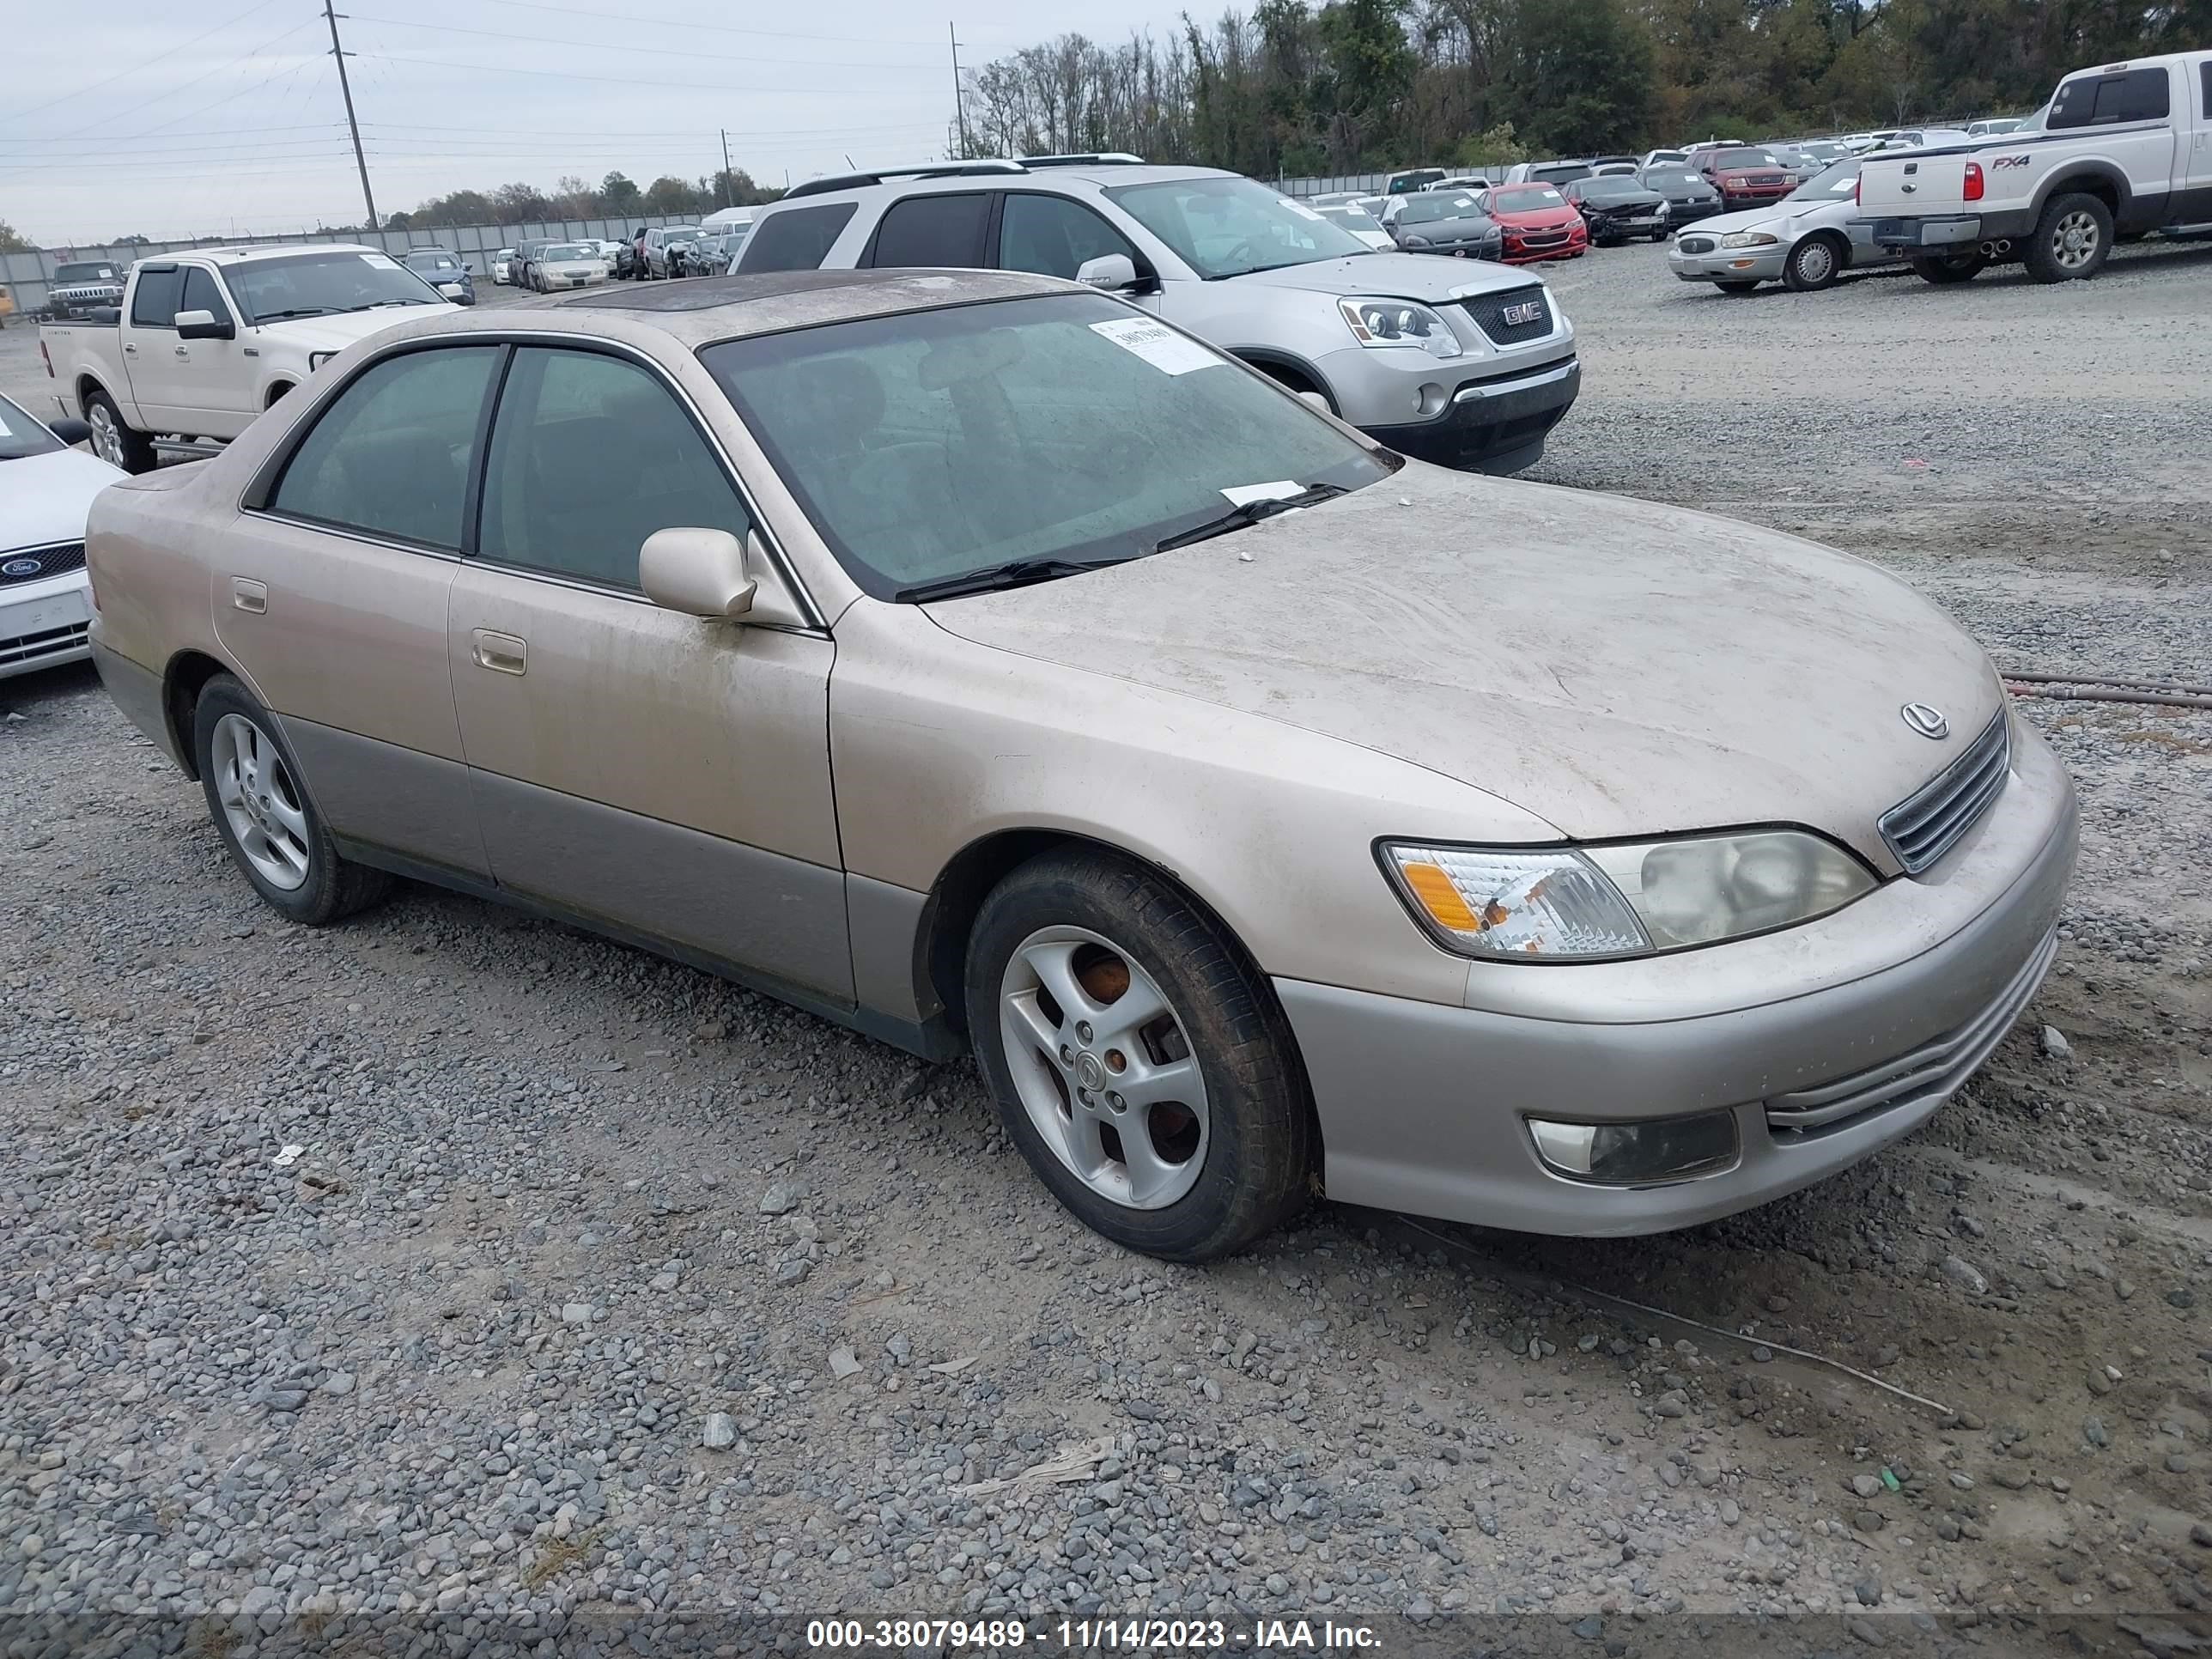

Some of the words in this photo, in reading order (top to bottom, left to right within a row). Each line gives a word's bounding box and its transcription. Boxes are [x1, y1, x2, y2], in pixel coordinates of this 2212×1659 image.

[1992, 155, 2031, 169] FX4
[1504, 301, 1542, 325] GMC
[1115, 328, 1170, 344] 38079489
[12, 562, 33, 572] Ford
